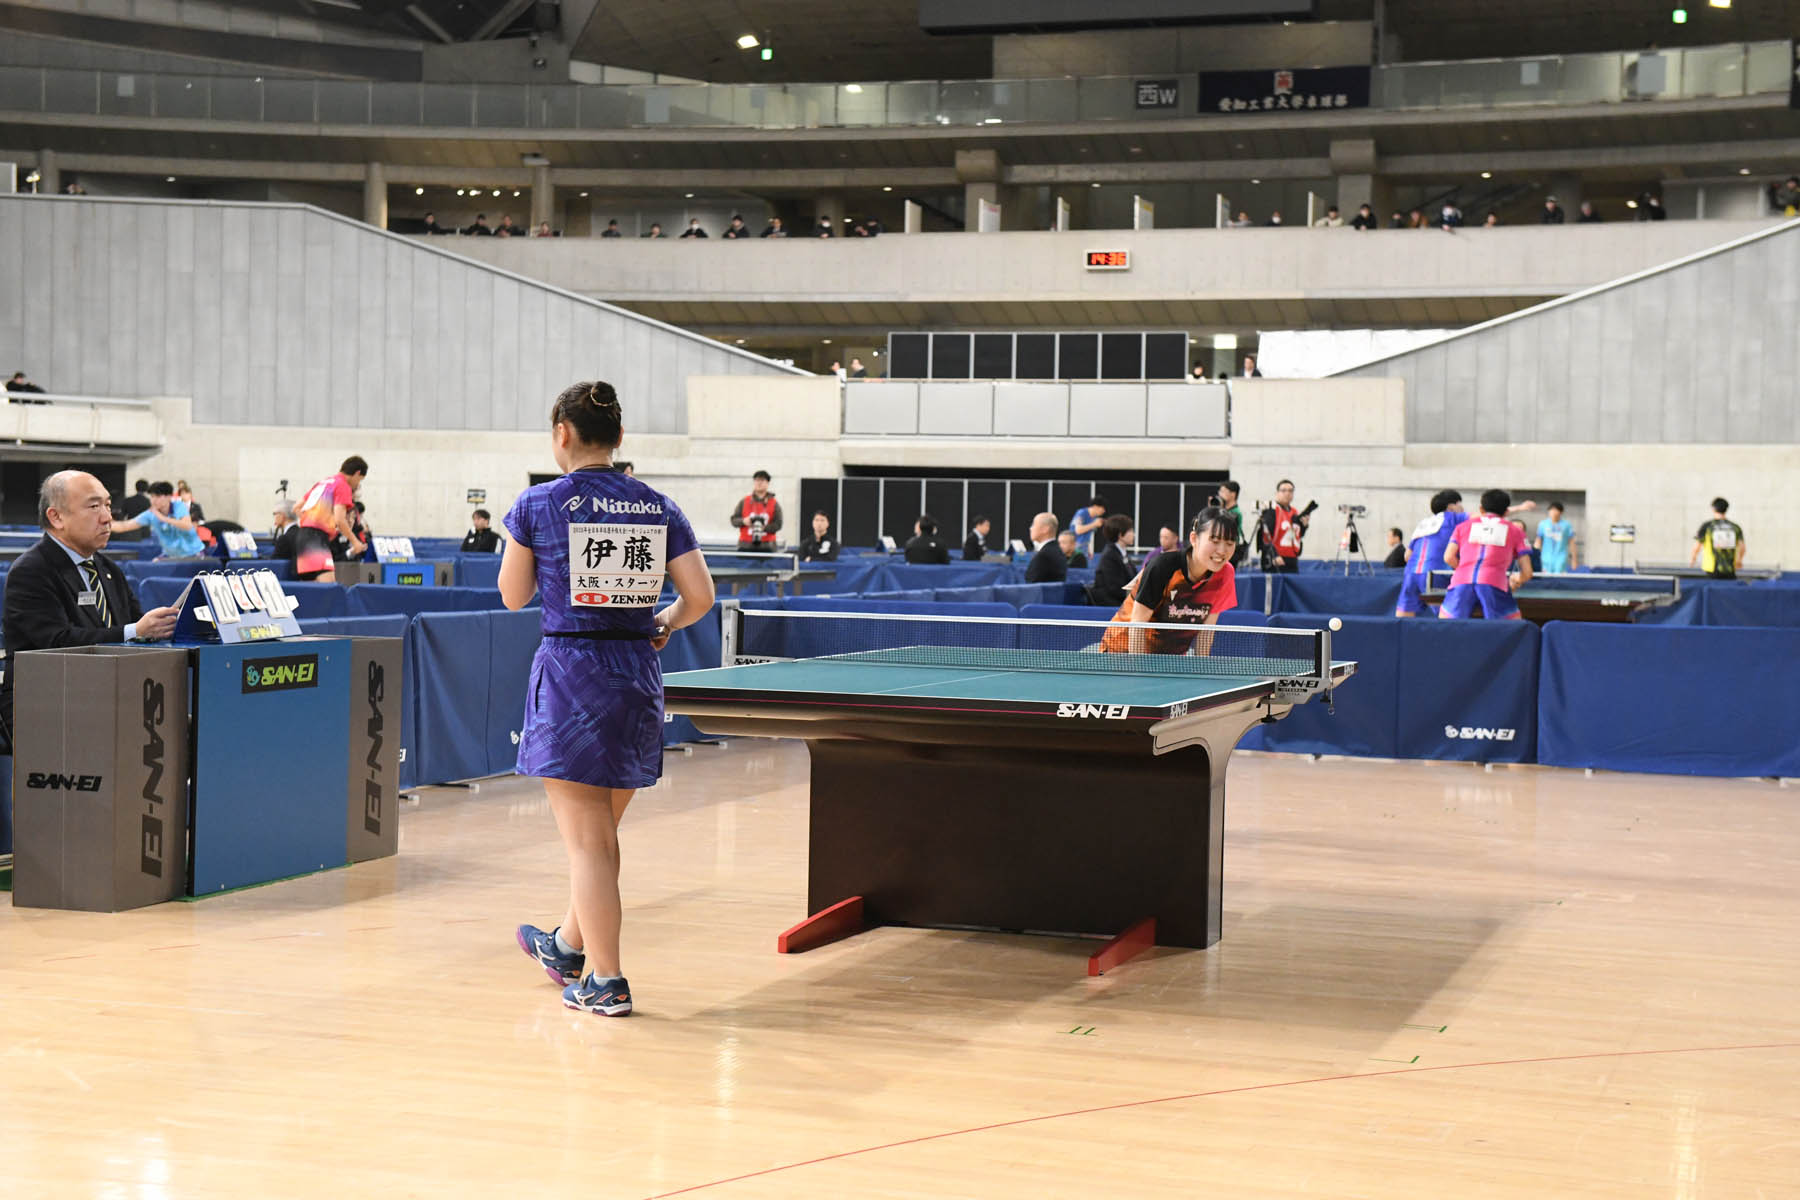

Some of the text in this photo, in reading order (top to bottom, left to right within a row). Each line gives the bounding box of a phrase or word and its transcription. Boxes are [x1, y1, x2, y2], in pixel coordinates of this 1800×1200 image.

[592, 496, 663, 515] Nittaku
[581, 535, 656, 573] 伊藤
[577, 575, 659, 589] 大阪・スターツ
[610, 594, 659, 605] ZEN-NOH
[260, 663, 314, 686] SAN-EI
[1278, 679, 1320, 688] SAN-EI
[1056, 703, 1132, 720] SAN-EI
[1170, 702, 1188, 719] SAN-EI
[1460, 727, 1516, 741] SAN-EI
[365, 660, 385, 836] SAN-EI
[27, 772, 102, 792] SAN-EI
[141, 678, 165, 879] SAN-EI
